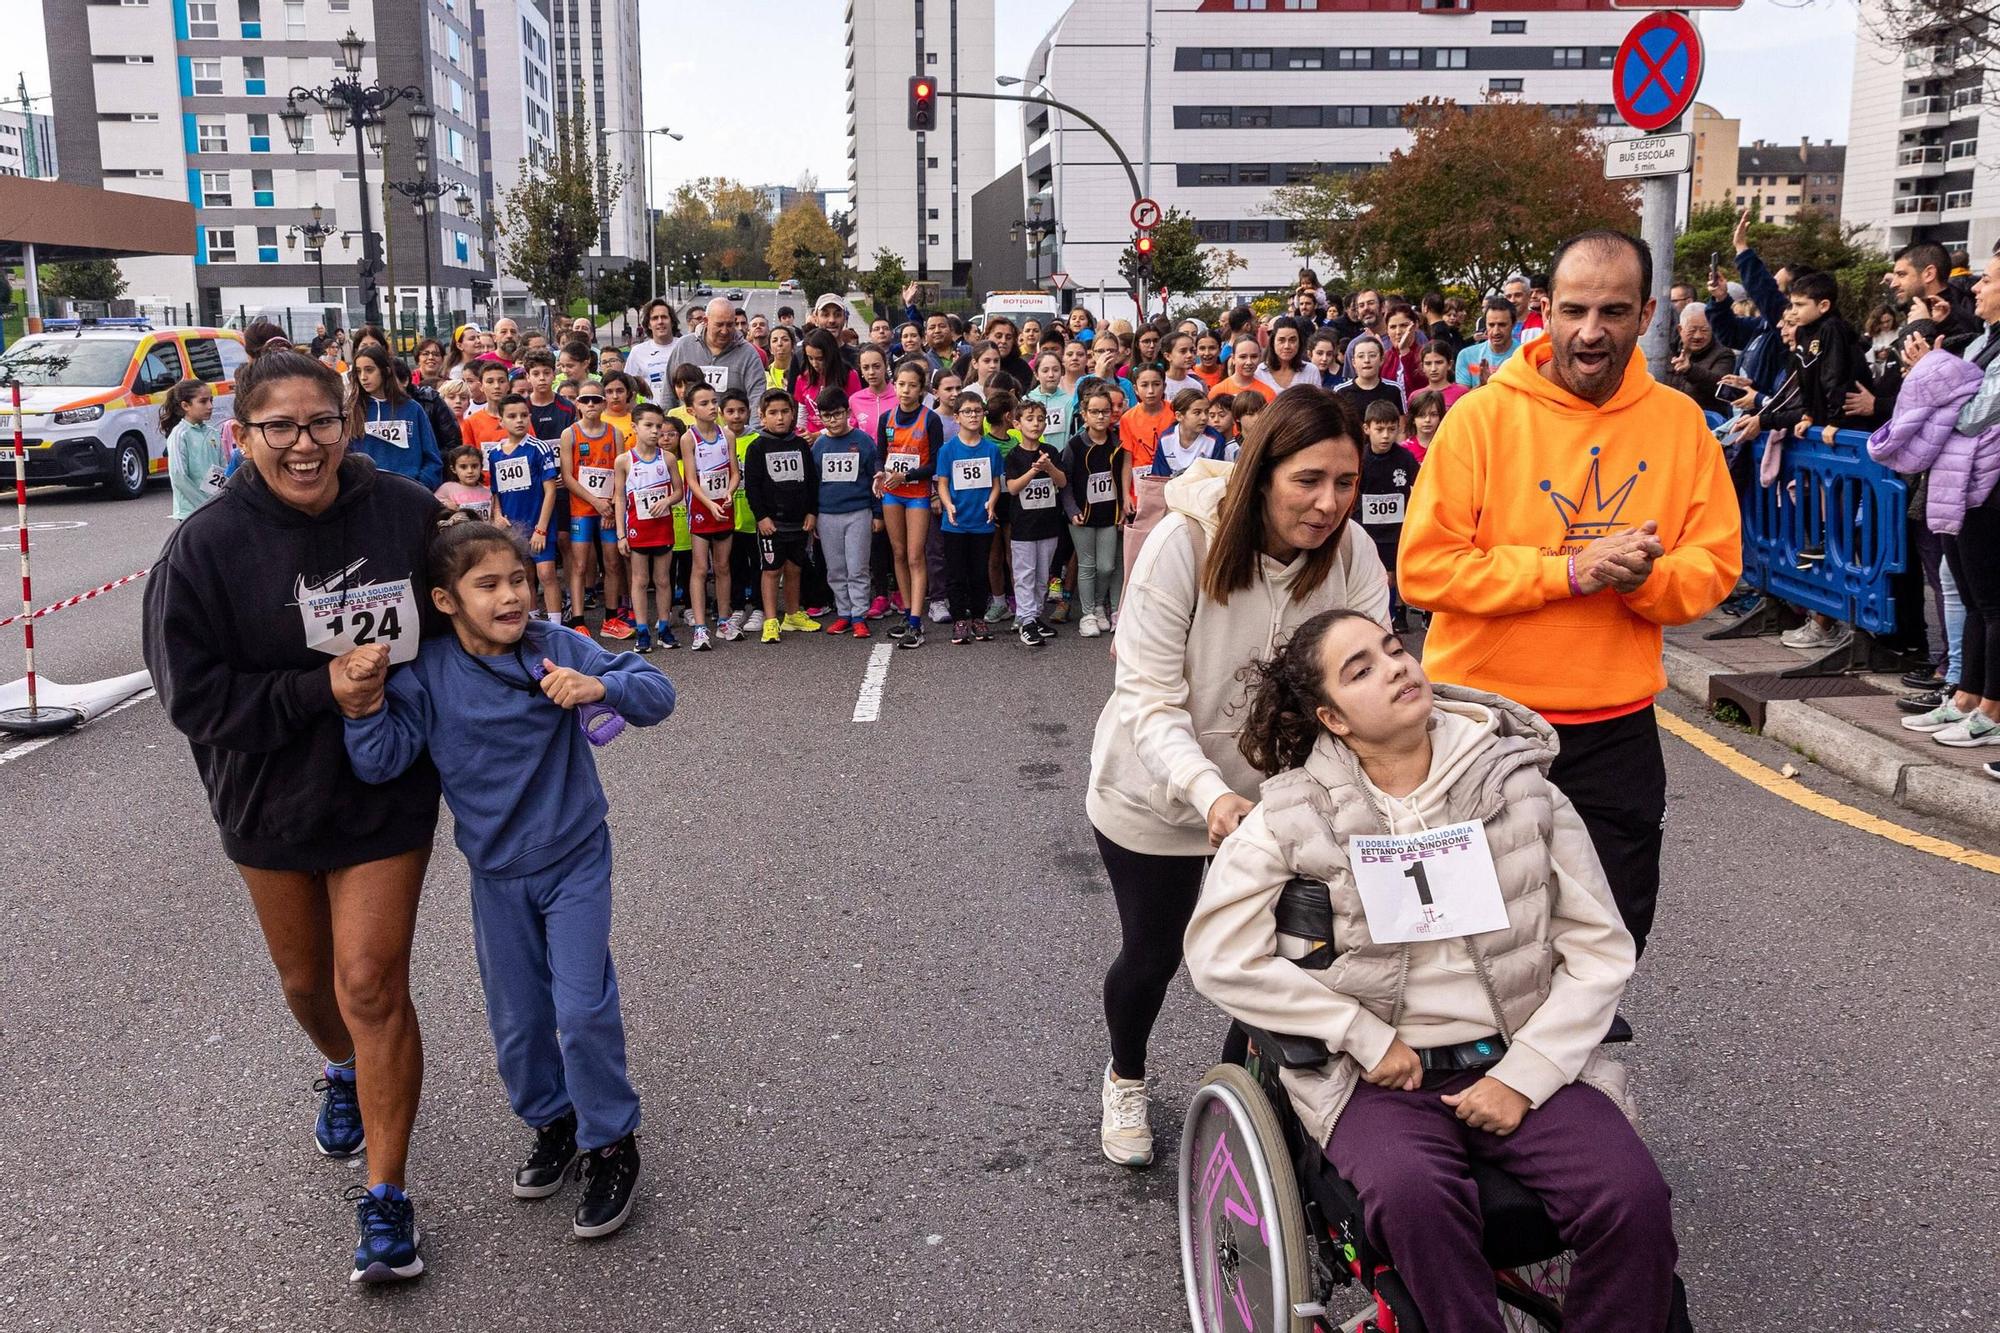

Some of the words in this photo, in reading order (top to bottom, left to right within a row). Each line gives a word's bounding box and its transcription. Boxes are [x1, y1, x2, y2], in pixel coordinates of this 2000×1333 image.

[1630, 139, 1666, 150] EXCEPTO
[1619, 152, 1635, 162] BUS
[1637, 149, 1675, 160] ESCOLAR
[1634, 163, 1639, 172] 5
[773, 458, 797, 472] 310
[827, 460, 853, 473] 313
[893, 461, 909, 473] 86
[499, 465, 523, 481] 340
[963, 466, 981, 480] 58
[588, 475, 606, 488] 87
[707, 476, 727, 491] 131
[1092, 479, 1112, 494] 107
[1025, 486, 1050, 500] 299
[1369, 501, 1397, 515] 309
[345, 591, 366, 600] MILLA
[368, 584, 405, 596] SOLIDARIA
[314, 599, 355, 611] RETTADO
[367, 591, 403, 602] SINDROME
[314, 607, 345, 618] DE
[351, 597, 404, 612] RETT
[326, 606, 402, 646] 124
[1356, 840, 1364, 848] XI
[1391, 838, 1419, 847] MILLA
[1421, 826, 1474, 842] SOLIDARIA
[1361, 847, 1404, 855] RETTANDO
[1407, 845, 1419, 853] AL
[1419, 834, 1470, 851] SINDROME
[1361, 855, 1394, 863] DE
[1400, 842, 1472, 861] RETT
[1403, 860, 1434, 906] 1
